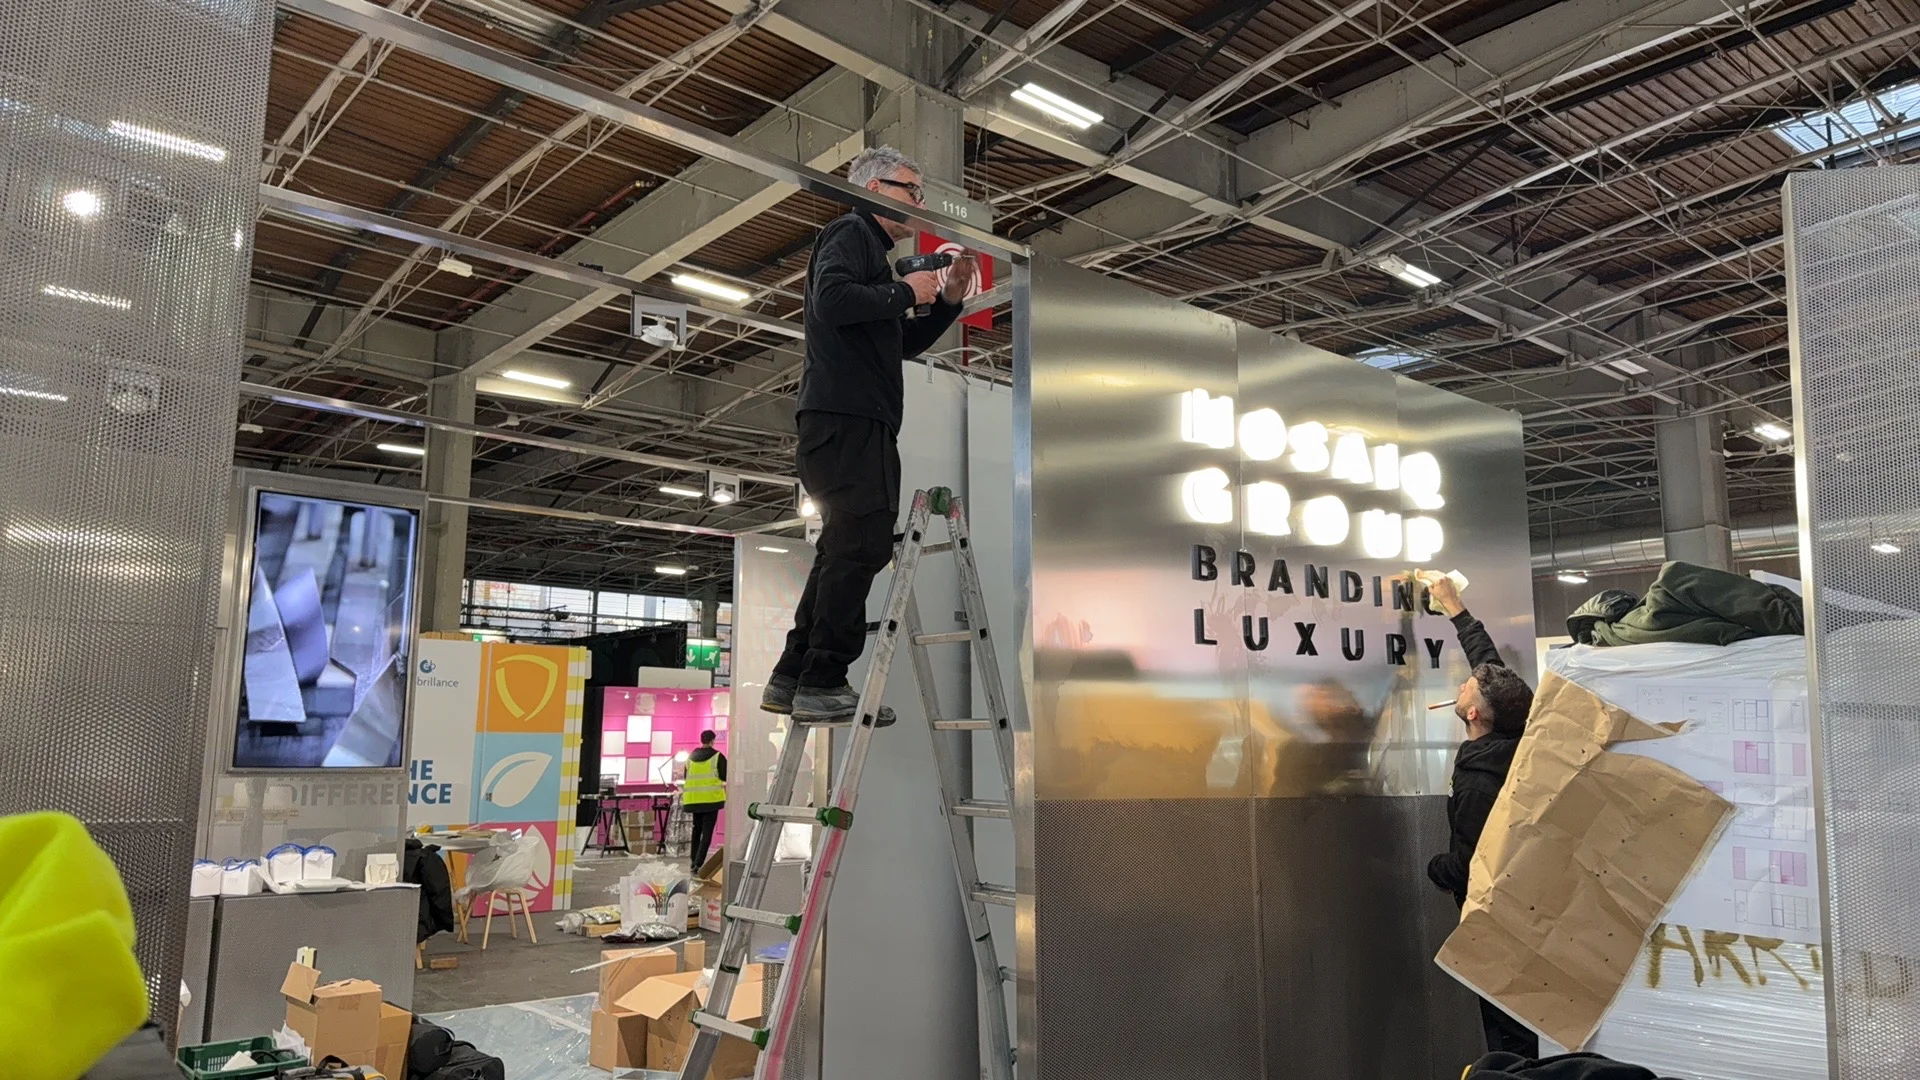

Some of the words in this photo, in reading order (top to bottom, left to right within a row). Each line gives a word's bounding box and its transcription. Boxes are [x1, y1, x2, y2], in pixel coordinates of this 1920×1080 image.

[942, 200, 968, 219] 1116
[1181, 387, 1445, 510] MOSAIQ
[1181, 466, 1444, 562] GROUP
[1193, 608, 1445, 669] LUXURY
[416, 676, 460, 688] brillance
[408, 759, 434, 781] HE
